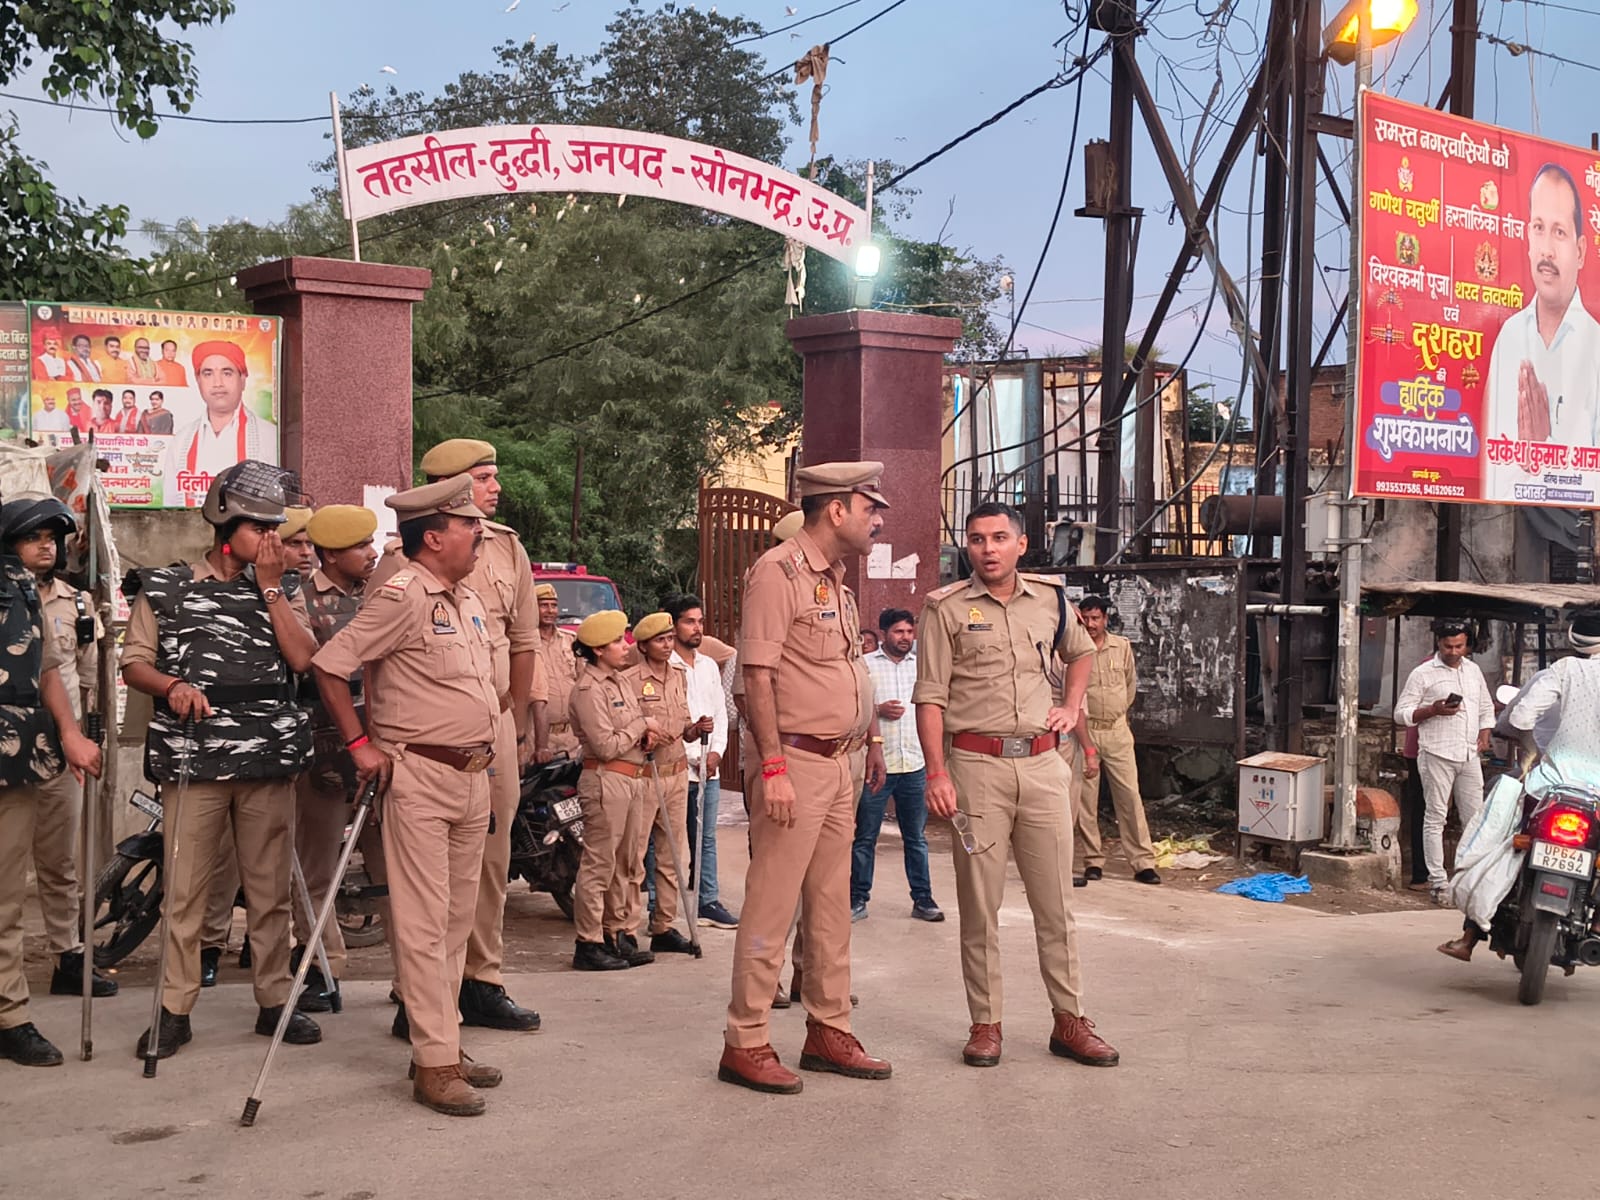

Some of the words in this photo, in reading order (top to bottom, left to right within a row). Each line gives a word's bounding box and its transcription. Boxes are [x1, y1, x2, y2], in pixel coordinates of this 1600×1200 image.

[1374, 118, 1418, 148] समस्त
[1491, 143, 1510, 169] को
[1369, 189, 1403, 216] गणेश
[1405, 198, 1440, 227] चतुर्थी
[1445, 204, 1500, 235] हरतालिका
[1368, 255, 1425, 292] विश्वकर्मा
[1427, 272, 1450, 300] पूजा
[1455, 281, 1480, 302] शरद
[1482, 284, 1524, 309] नवरात्रि
[1411, 322, 1484, 370] दशहरा
[1398, 376, 1446, 421] हार्दिक
[1487, 433, 1527, 463] राकेश
[1530, 442, 1568, 473] कुमार
[1514, 484, 1547, 500] सभासद
[1542, 856, 1583, 873] R7694
[1544, 844, 1584, 863] UP64A
